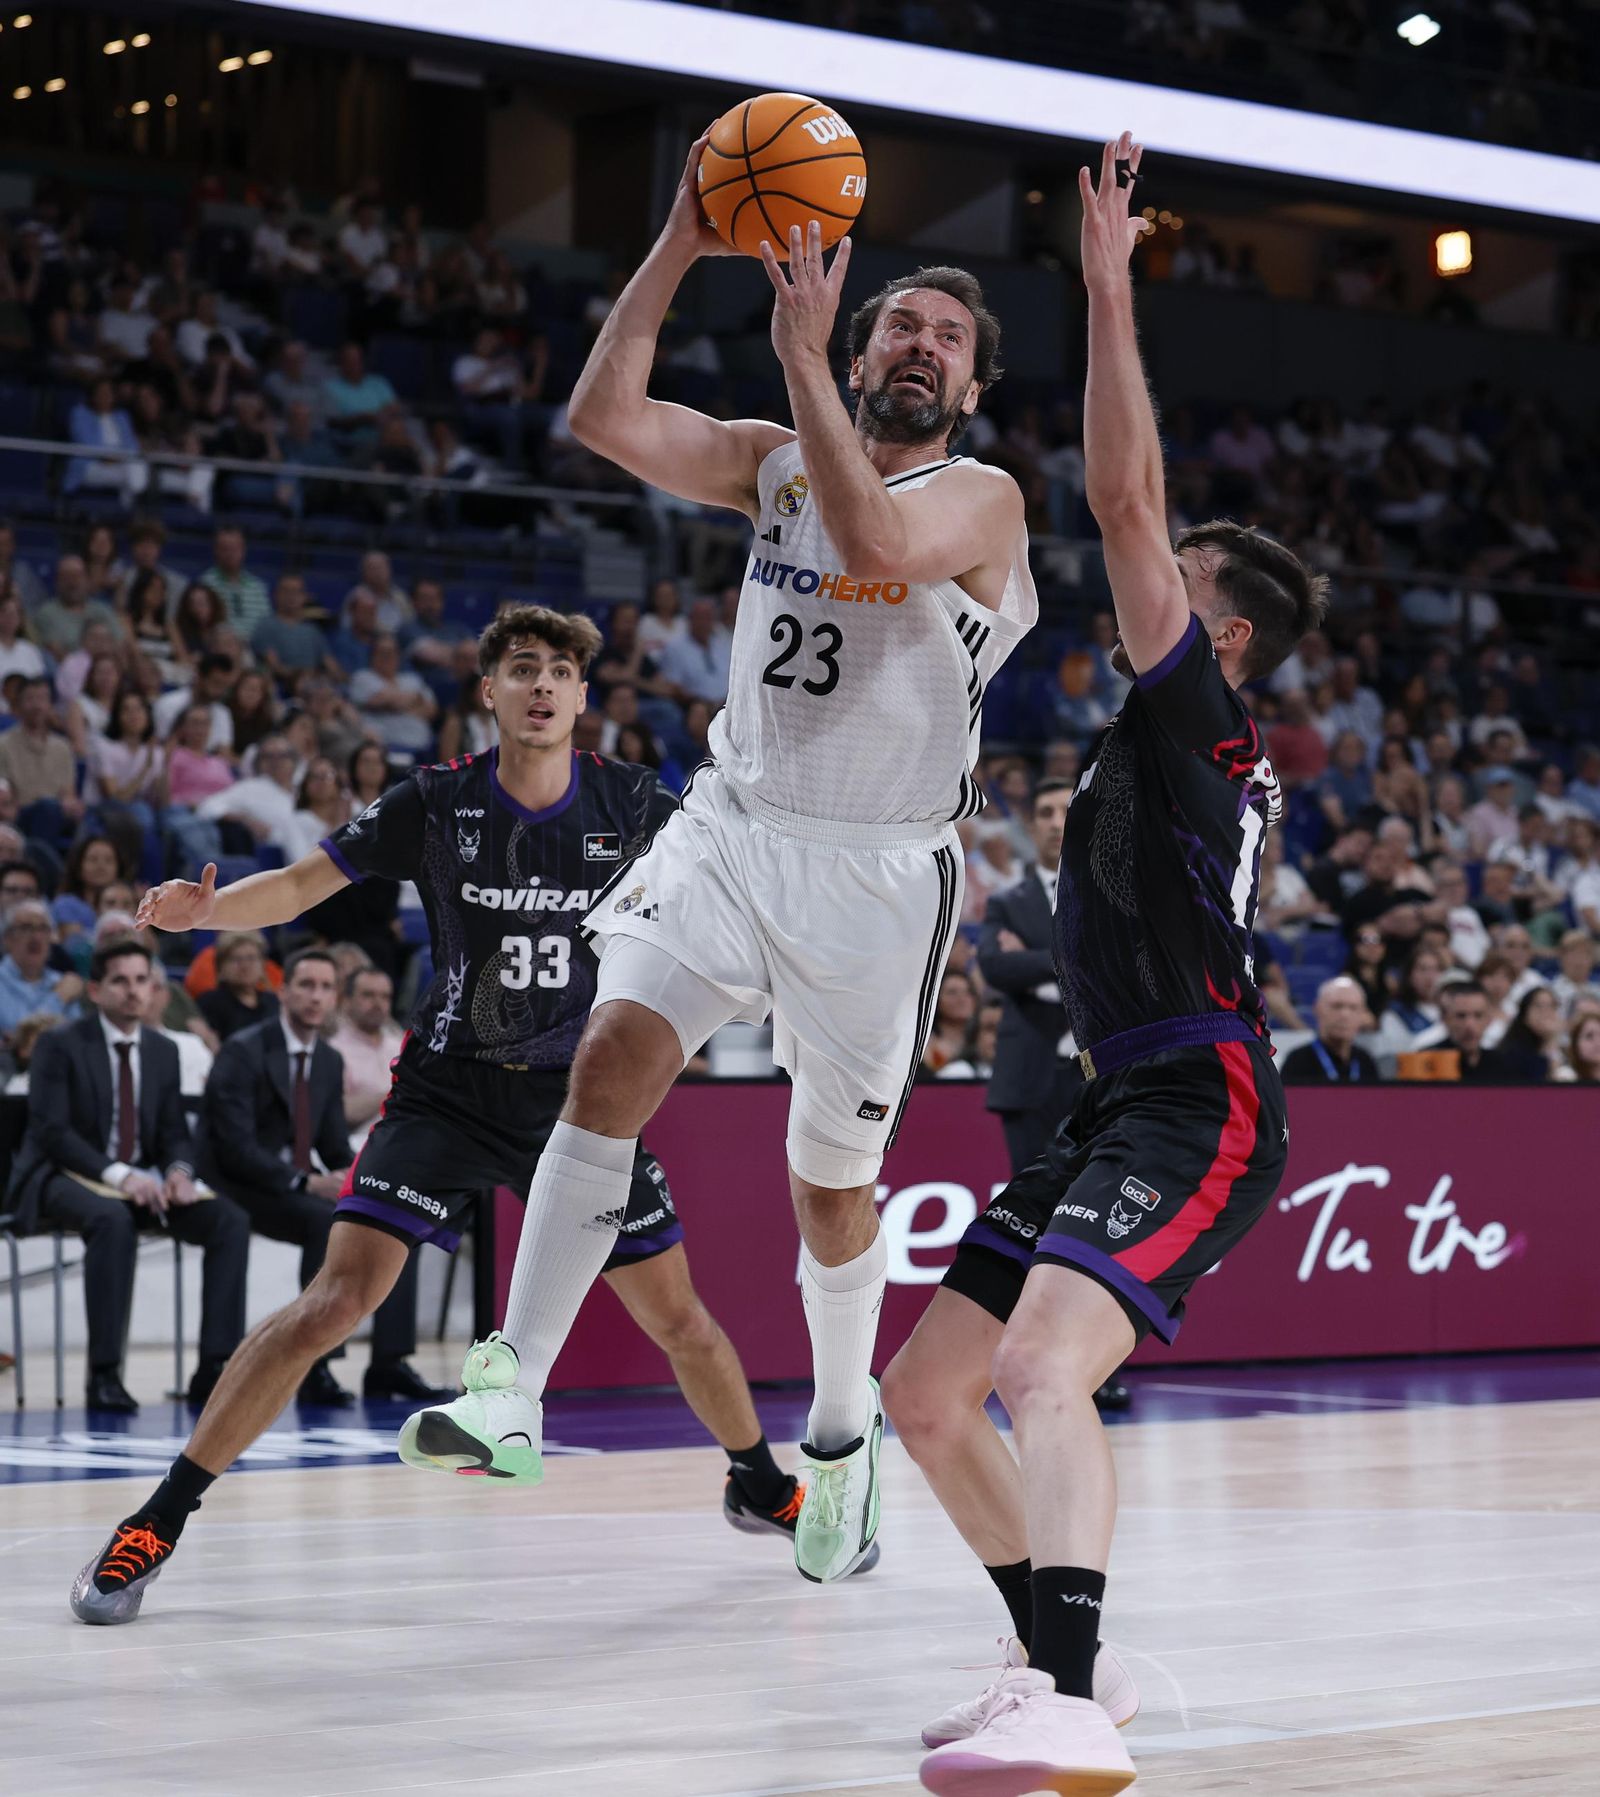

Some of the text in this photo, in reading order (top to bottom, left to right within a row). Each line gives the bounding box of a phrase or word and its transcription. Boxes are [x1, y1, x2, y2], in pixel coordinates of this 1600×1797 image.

[749, 557, 909, 605] AUTOHERO
[762, 613, 843, 696] 23
[454, 806, 486, 818] vive
[587, 849, 619, 857] endesa
[500, 935, 571, 990] 33
[860, 1108, 881, 1120] acb
[359, 1175, 441, 1216] vive asisa
[1125, 1184, 1149, 1204] acb
[1277, 1162, 1514, 1282] Tu tre
[1060, 1593, 1104, 1612] vive
